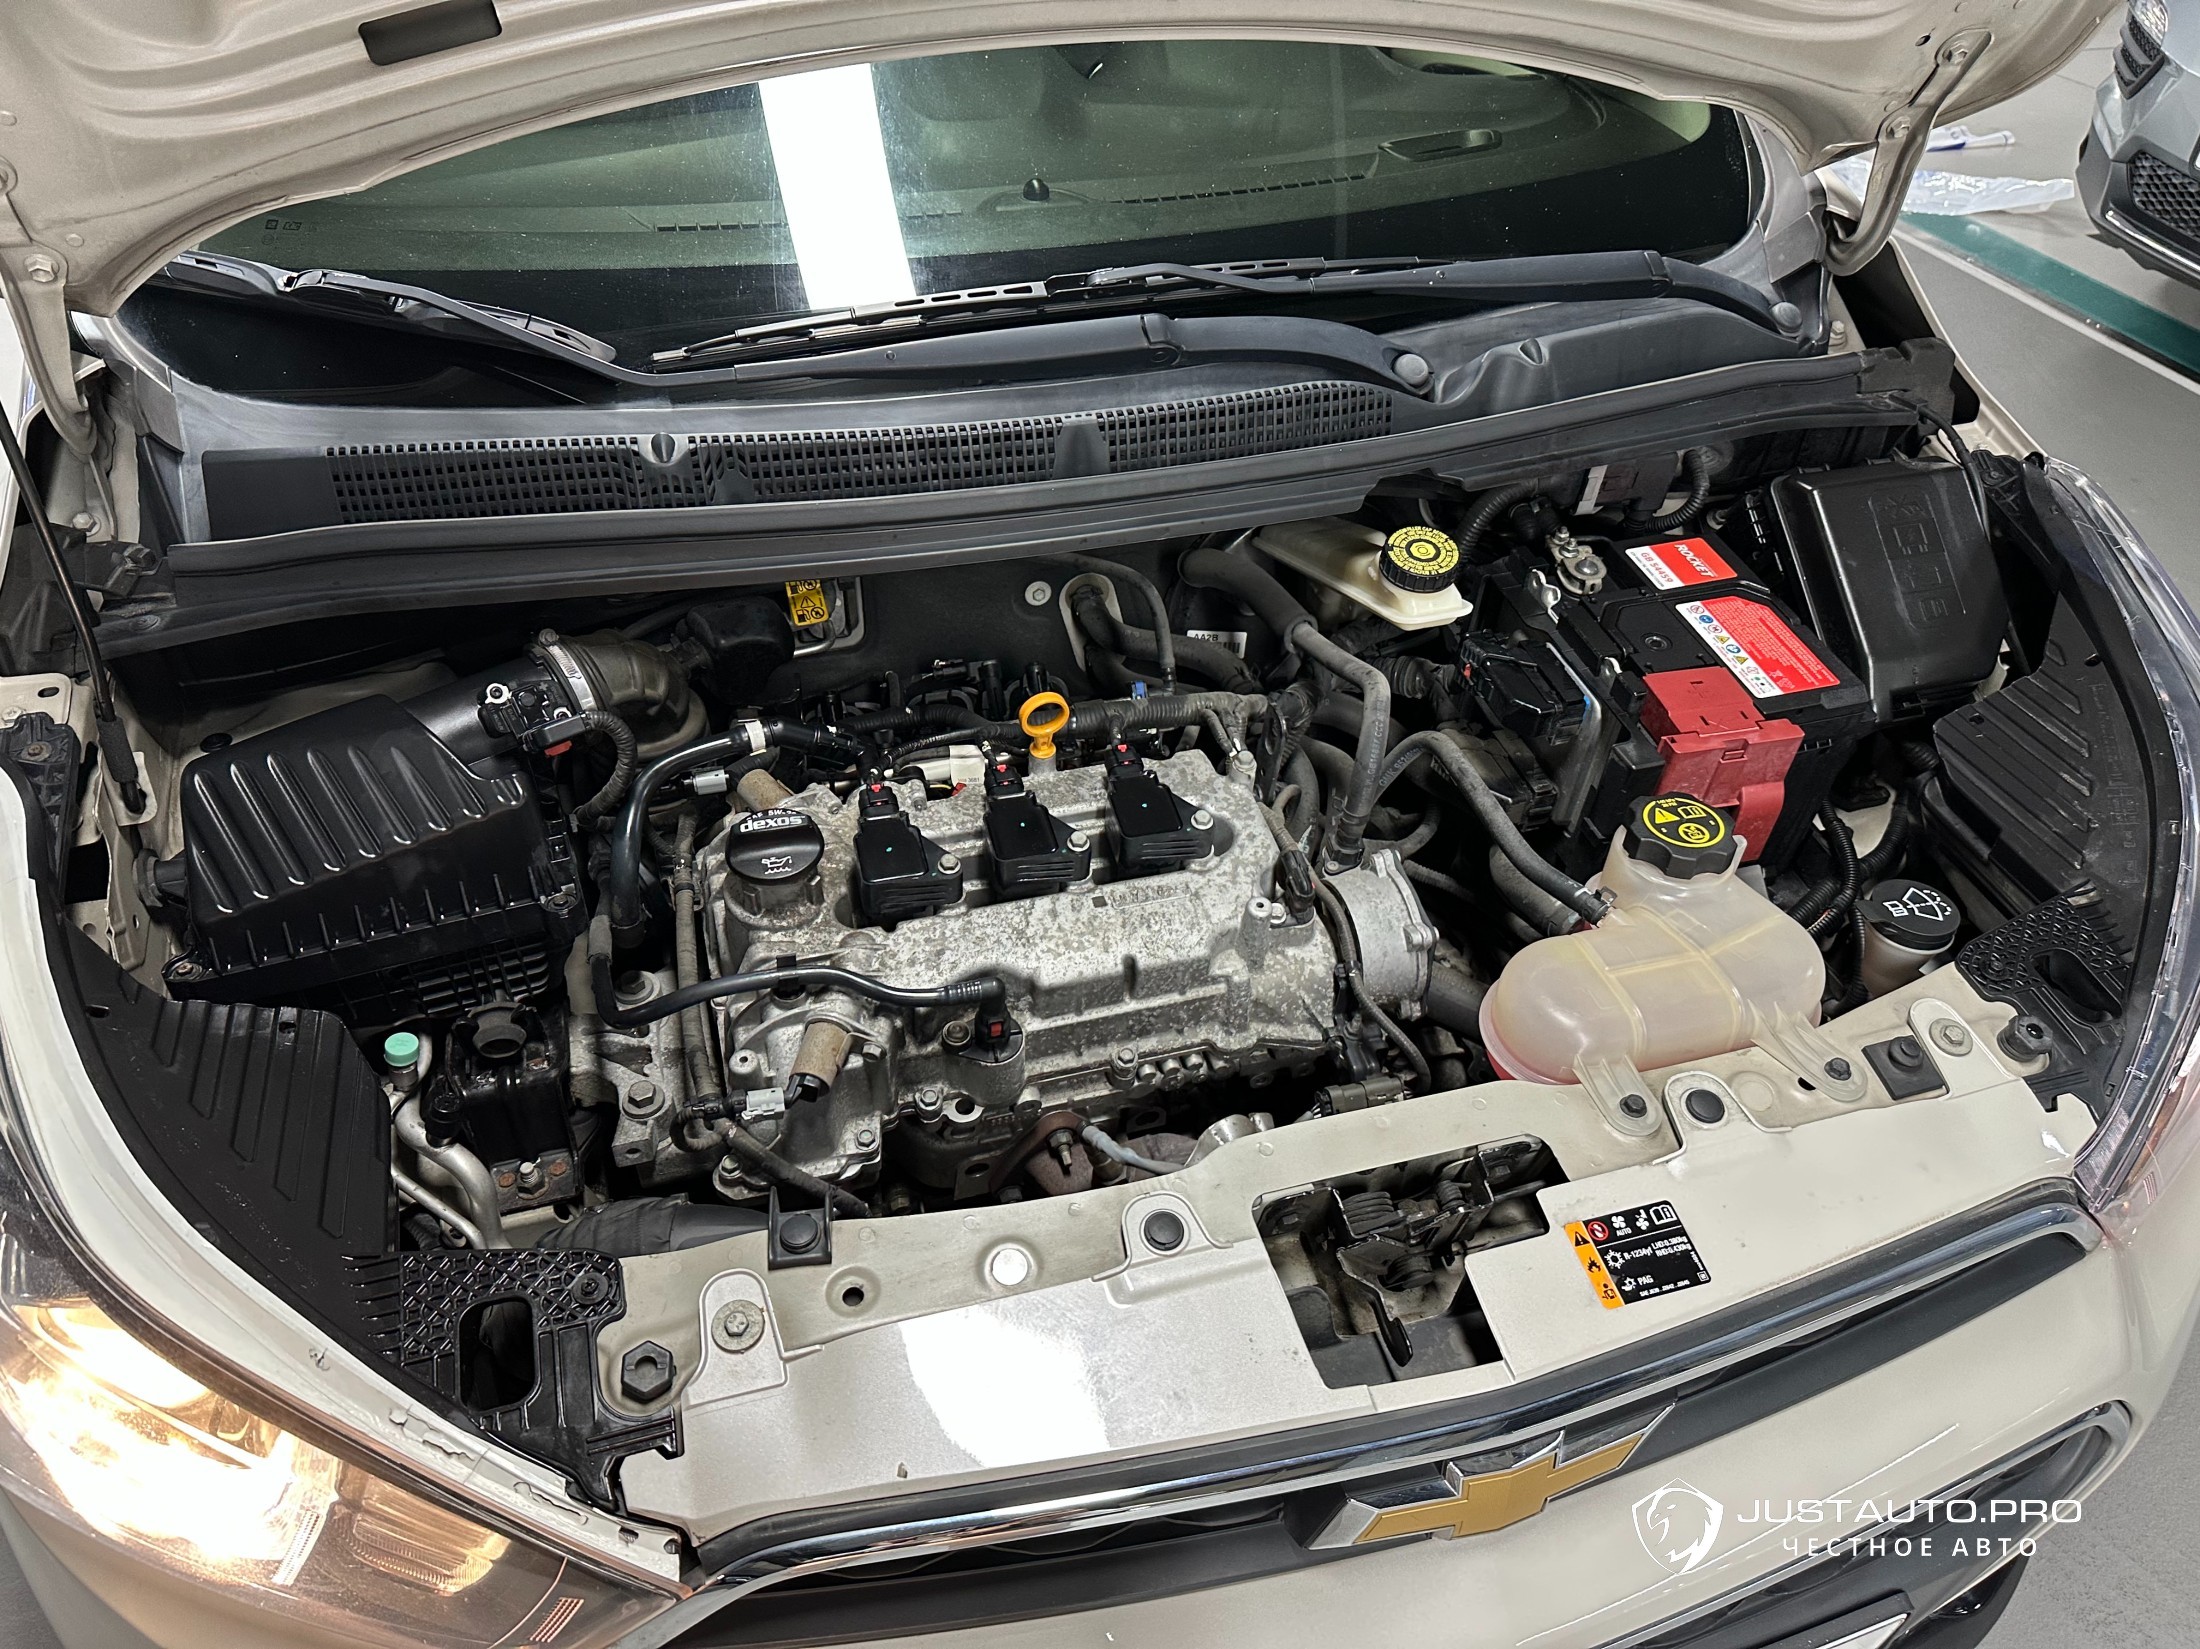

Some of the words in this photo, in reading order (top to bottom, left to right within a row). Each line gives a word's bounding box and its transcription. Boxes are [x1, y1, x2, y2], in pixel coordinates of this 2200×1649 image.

[1640, 552, 1654, 563] GB
[1650, 560, 1674, 583] 54459
[1674, 543, 1715, 578] ROCKET
[740, 816, 803, 832] dexos
[1616, 1227, 1632, 1237] AUTO
[1637, 1274, 1654, 1286] PAG
